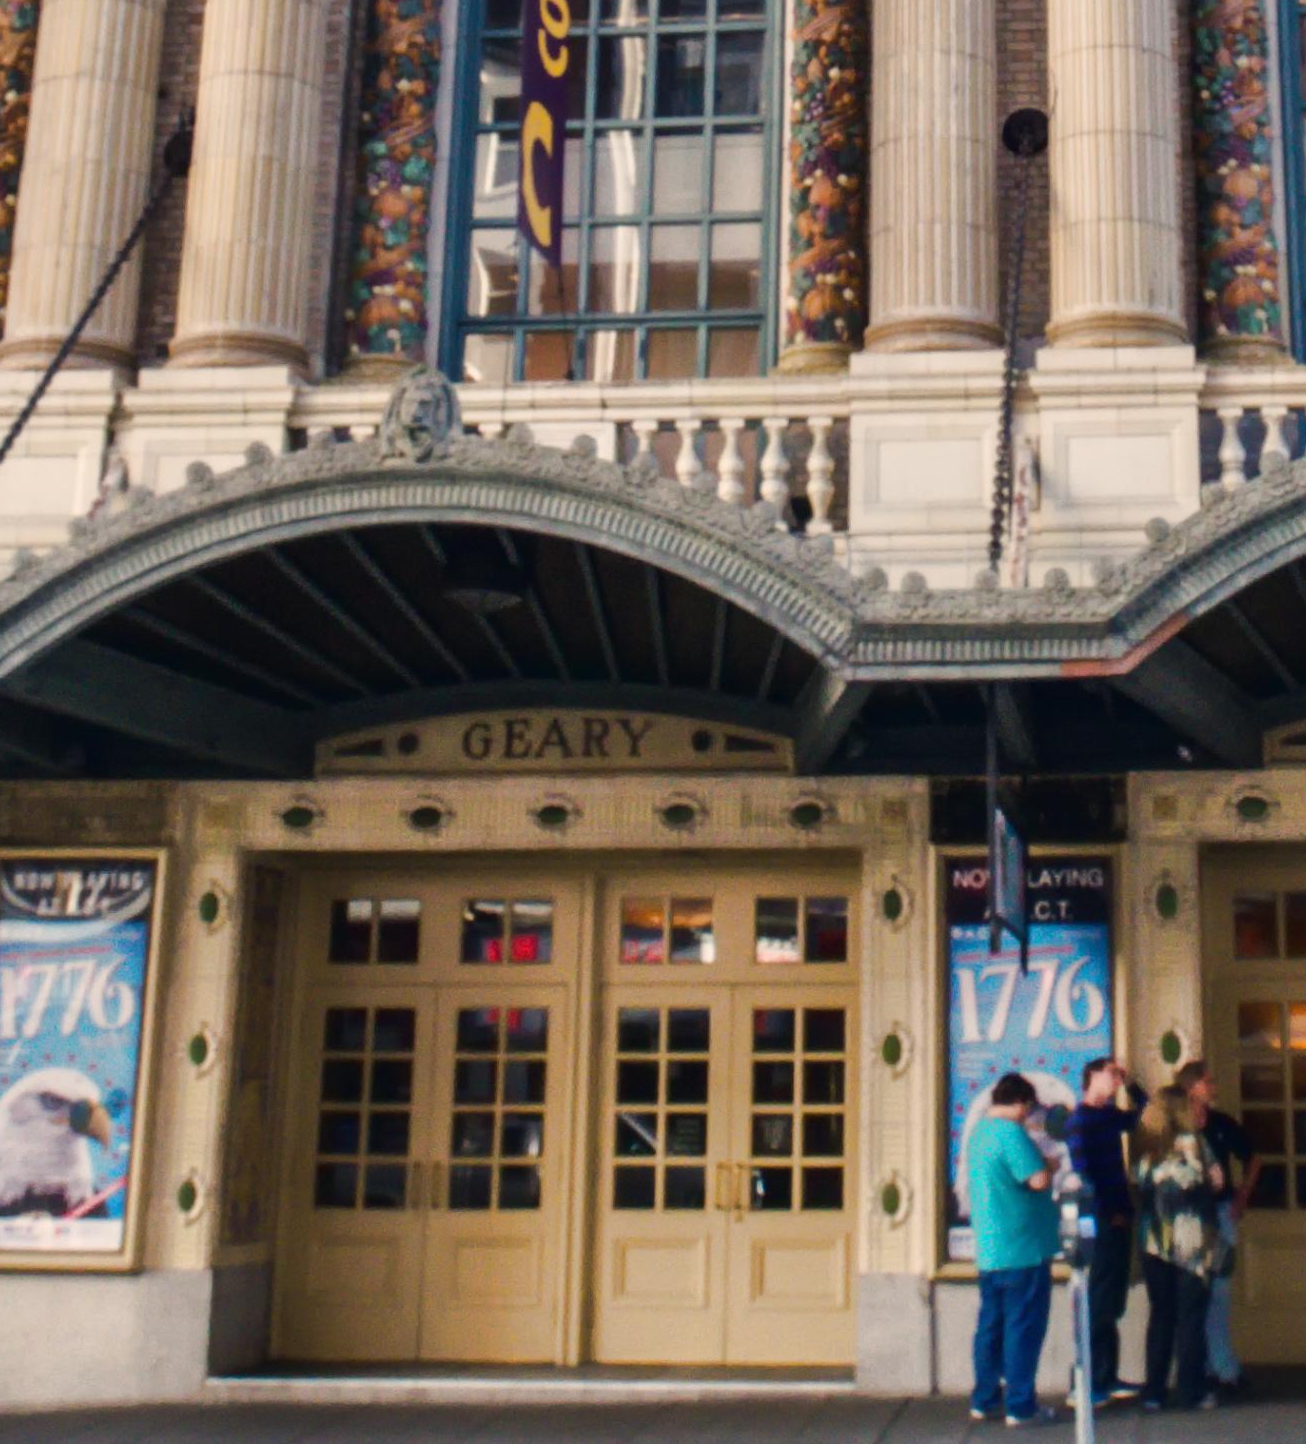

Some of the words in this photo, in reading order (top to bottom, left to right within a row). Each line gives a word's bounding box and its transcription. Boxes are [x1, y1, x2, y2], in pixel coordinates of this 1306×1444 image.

[461, 716, 655, 760] GEARY
[953, 869, 990, 888] NO
[1026, 868, 1105, 888] LAYING
[954, 956, 1105, 1044] 1776
